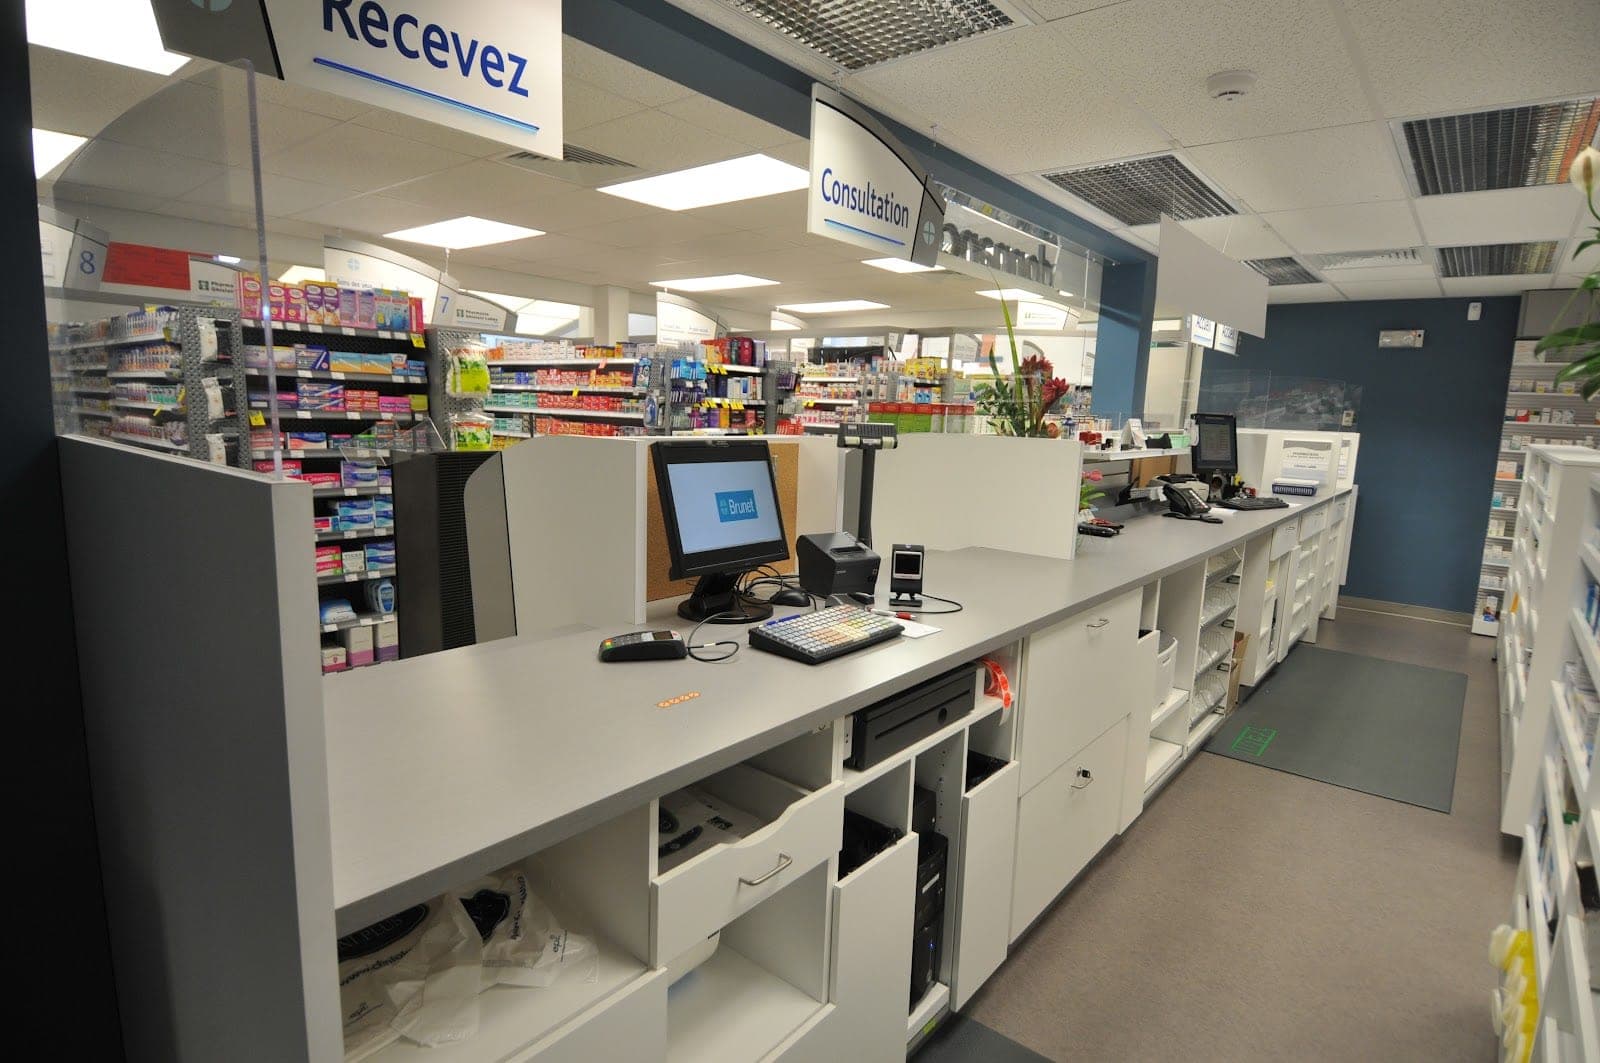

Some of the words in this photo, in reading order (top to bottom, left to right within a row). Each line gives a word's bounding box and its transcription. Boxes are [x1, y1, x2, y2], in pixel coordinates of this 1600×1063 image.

[322, 0, 530, 97] Recevez
[821, 168, 910, 229] Consultation
[80, 250, 96, 274] 8
[440, 296, 449, 314] 7
[728, 499, 755, 515] Brunet
